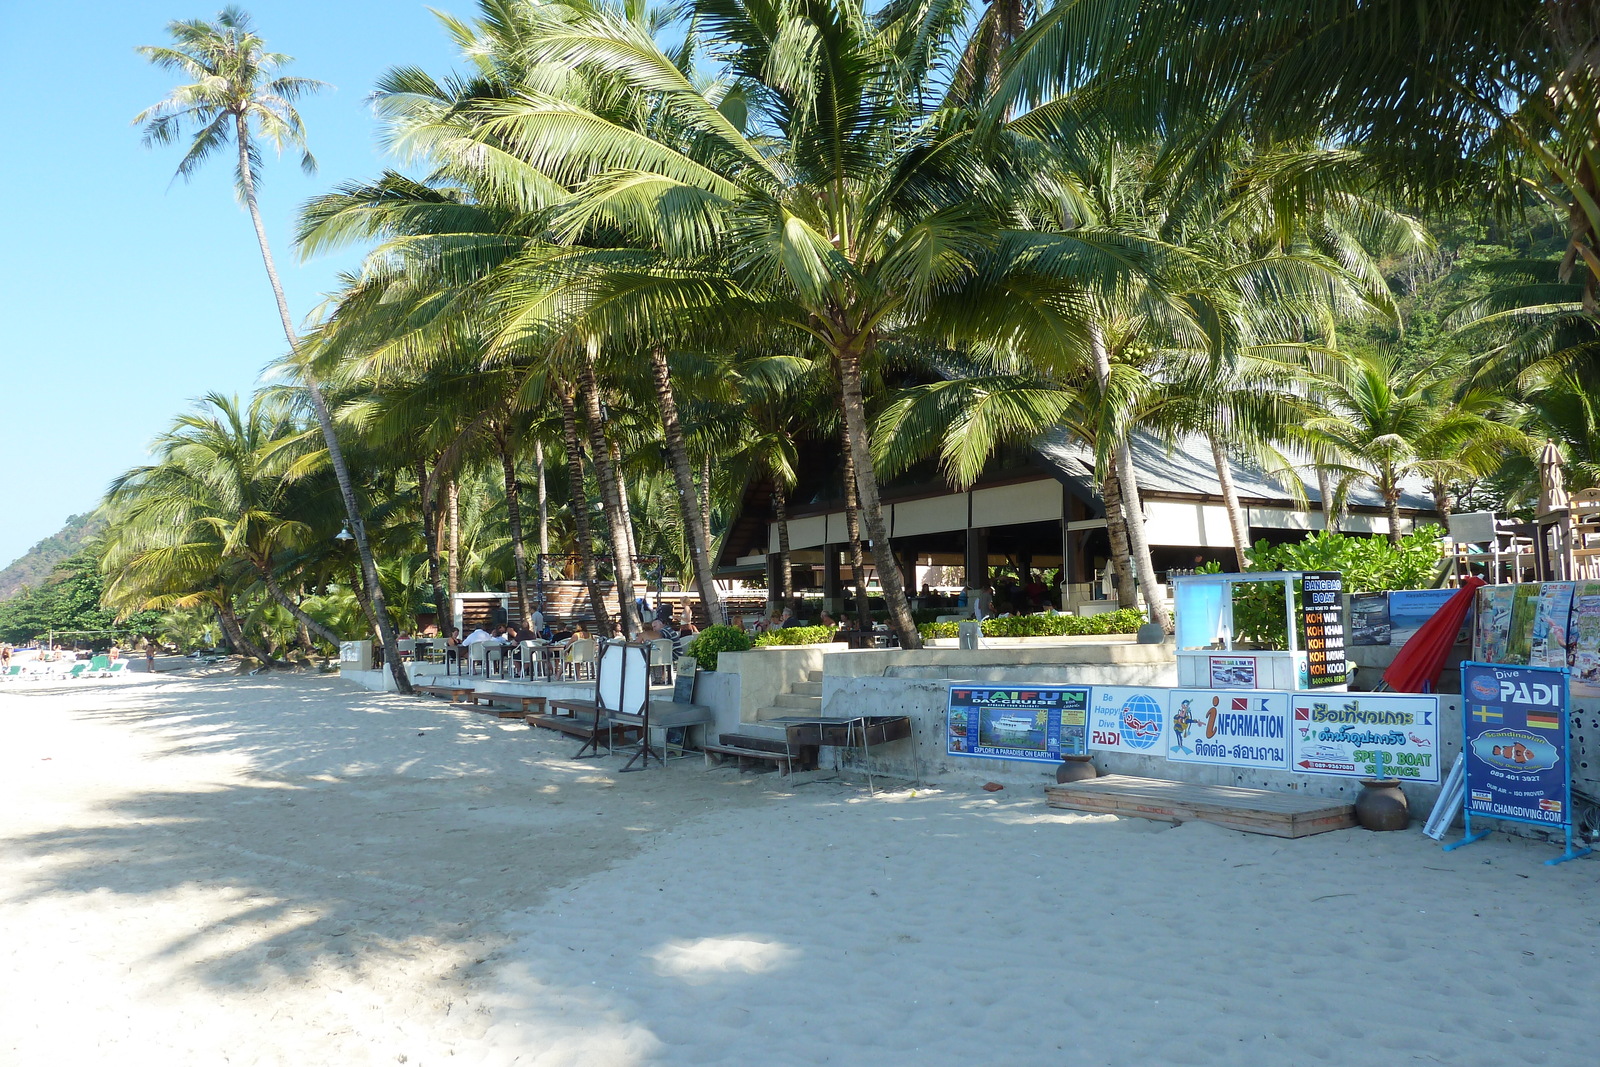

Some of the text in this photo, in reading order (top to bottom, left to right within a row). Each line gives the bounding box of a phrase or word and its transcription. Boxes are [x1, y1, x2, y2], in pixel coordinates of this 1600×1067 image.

[1312, 592, 1336, 603] BOAT
[1305, 612, 1338, 623] KOH WAI
[1306, 626, 1324, 637] KOH
[1308, 639, 1325, 650] KOH
[1308, 651, 1325, 662] KOH
[1310, 662, 1345, 675] KOH KOOD
[1495, 671, 1519, 679] Dive
[953, 690, 1084, 702] THAIFUN
[1500, 680, 1559, 707] PADI
[1098, 720, 1115, 728] Dive
[1092, 730, 1120, 746] PADI
[1485, 732, 1545, 744] Scandinavian
[974, 747, 995, 755] EXPLORE
[1000, 749, 1024, 757] PARADISE
[1353, 750, 1433, 767] SPED BOAT
[1486, 783, 1498, 791] OUR
[1472, 800, 1561, 822] WWW.CHANGDIVING.COM
